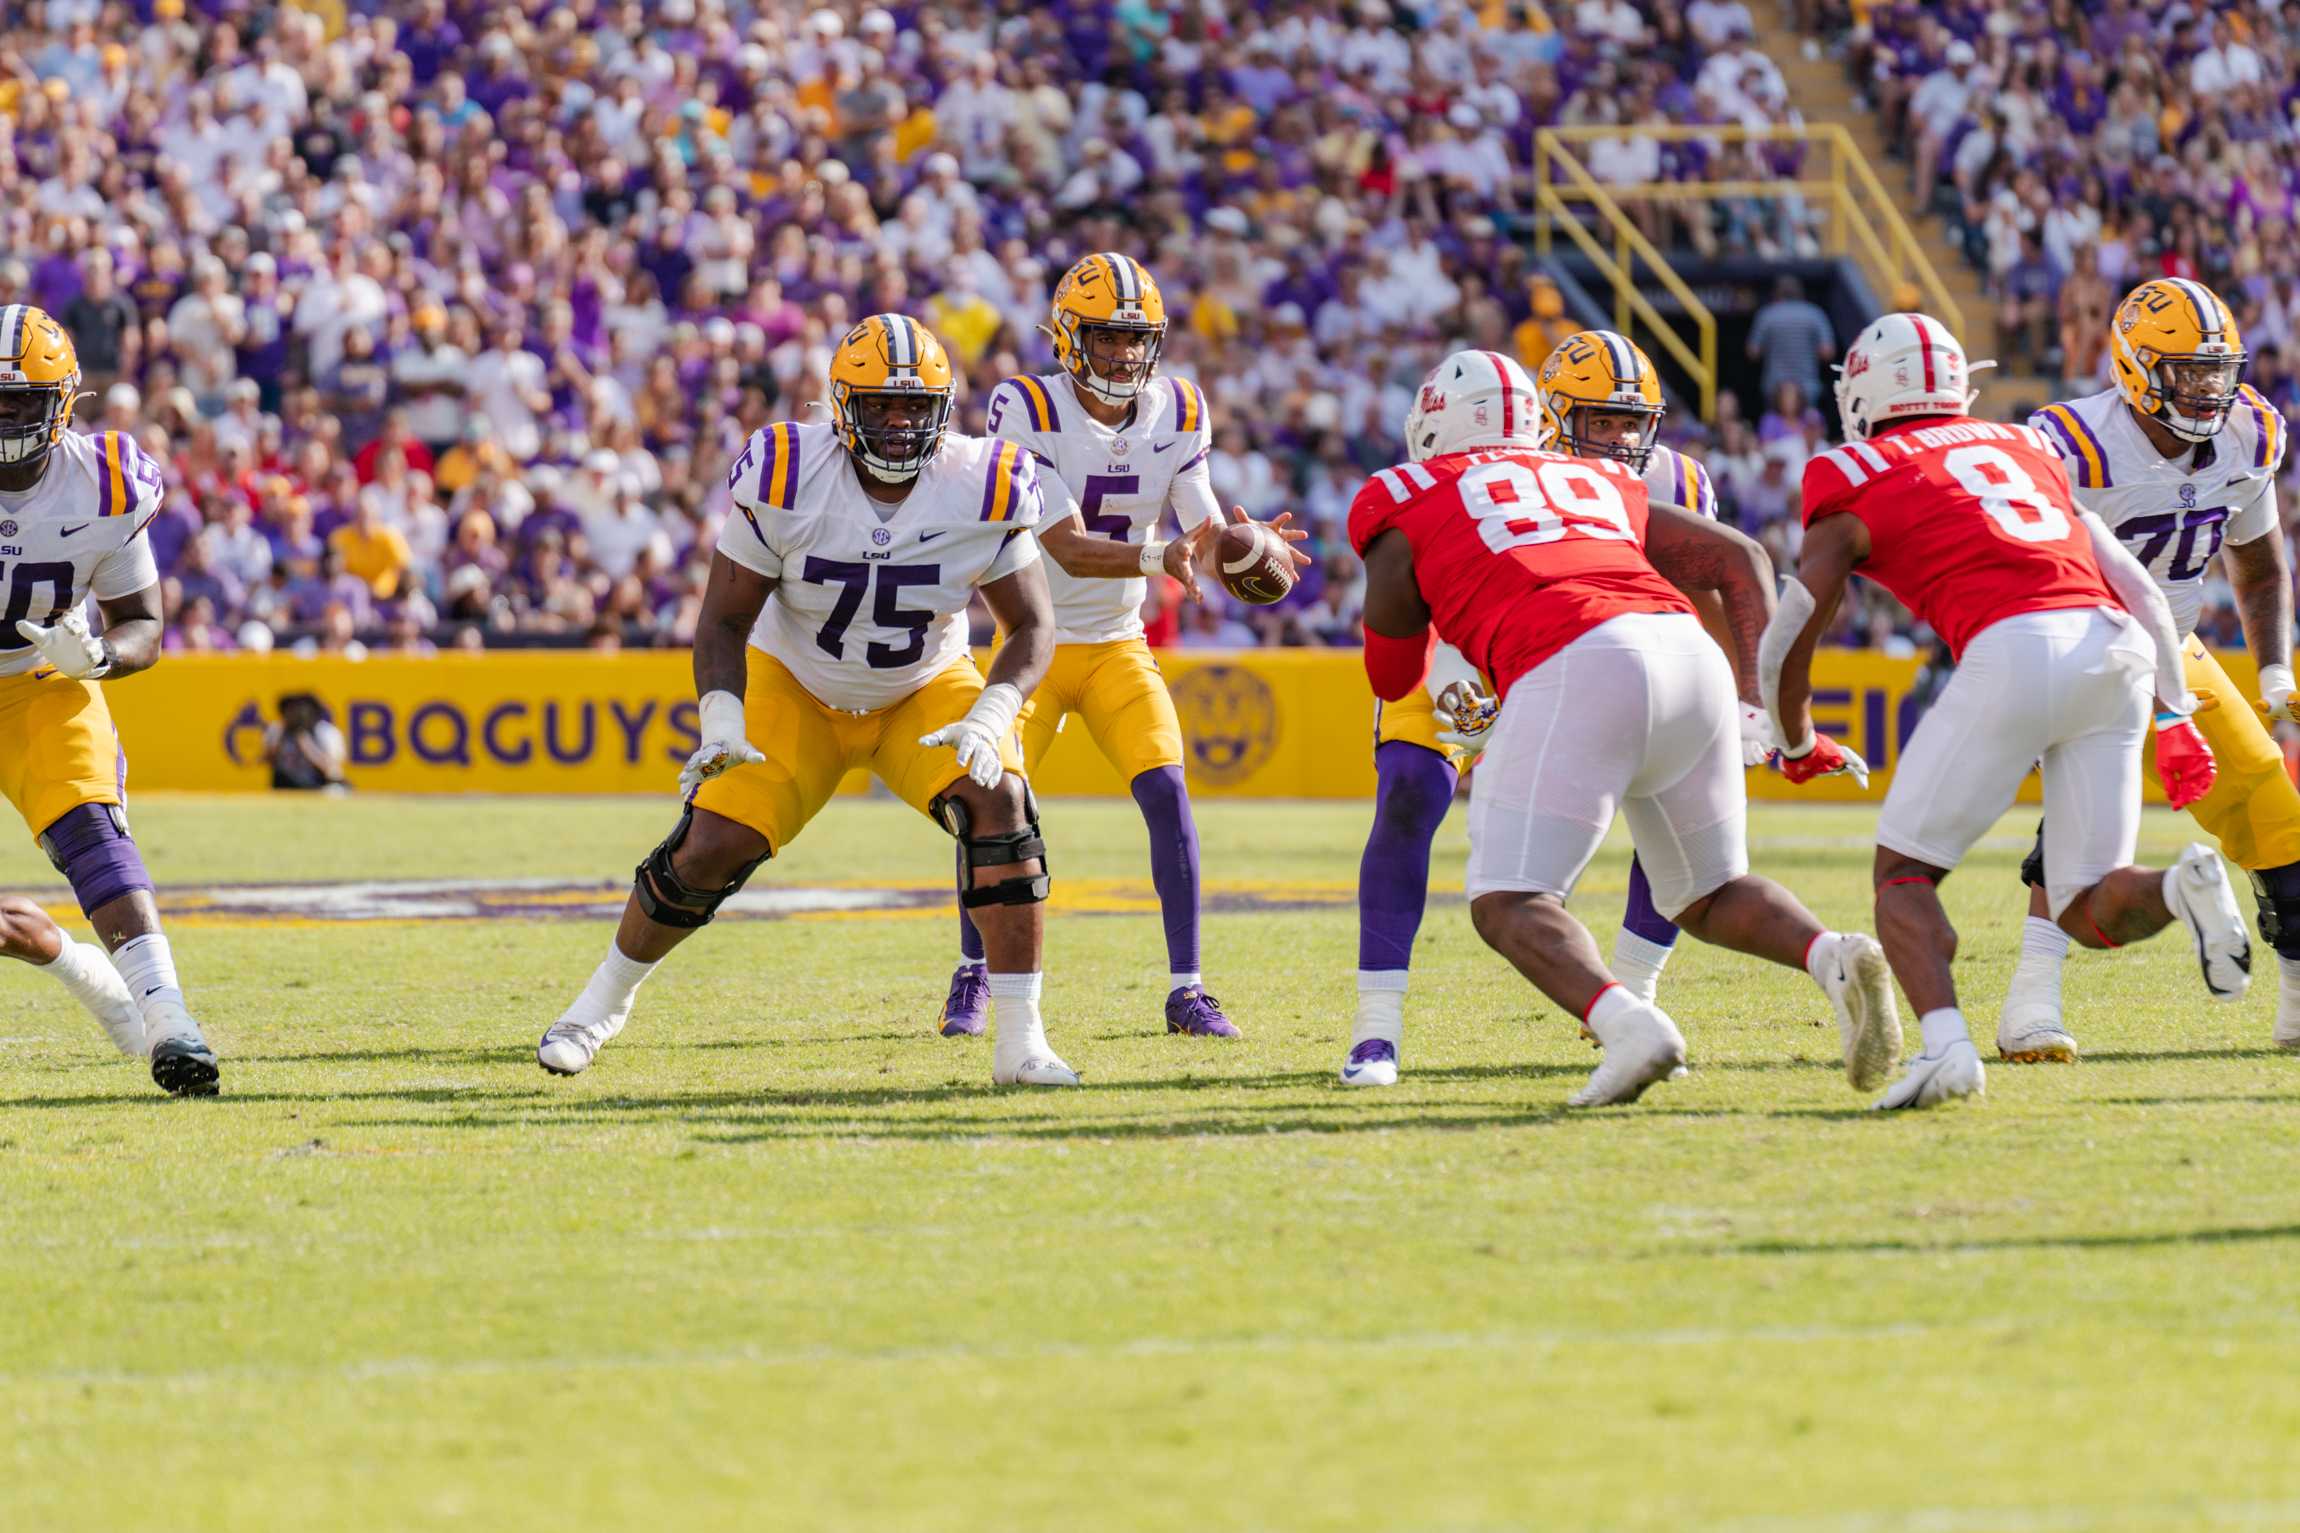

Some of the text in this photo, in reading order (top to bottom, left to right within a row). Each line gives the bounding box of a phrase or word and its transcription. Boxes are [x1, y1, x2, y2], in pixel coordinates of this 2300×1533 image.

[1121, 312, 1140, 320] LSU
[0, 372, 16, 381] SU
[988, 393, 1011, 433] 5
[1910, 421, 2017, 448] BROWN
[1107, 464, 1130, 472] LSU
[1943, 444, 2072, 542] 8
[1080, 474, 1140, 544] 5
[1456, 460, 1641, 555] 89
[0, 544, 23, 556] SU
[862, 550, 891, 560] LSU
[2114, 506, 2229, 581] 70
[0, 560, 75, 650] 0
[801, 555, 941, 669] 75
[318, 701, 701, 767] BQGUYS
